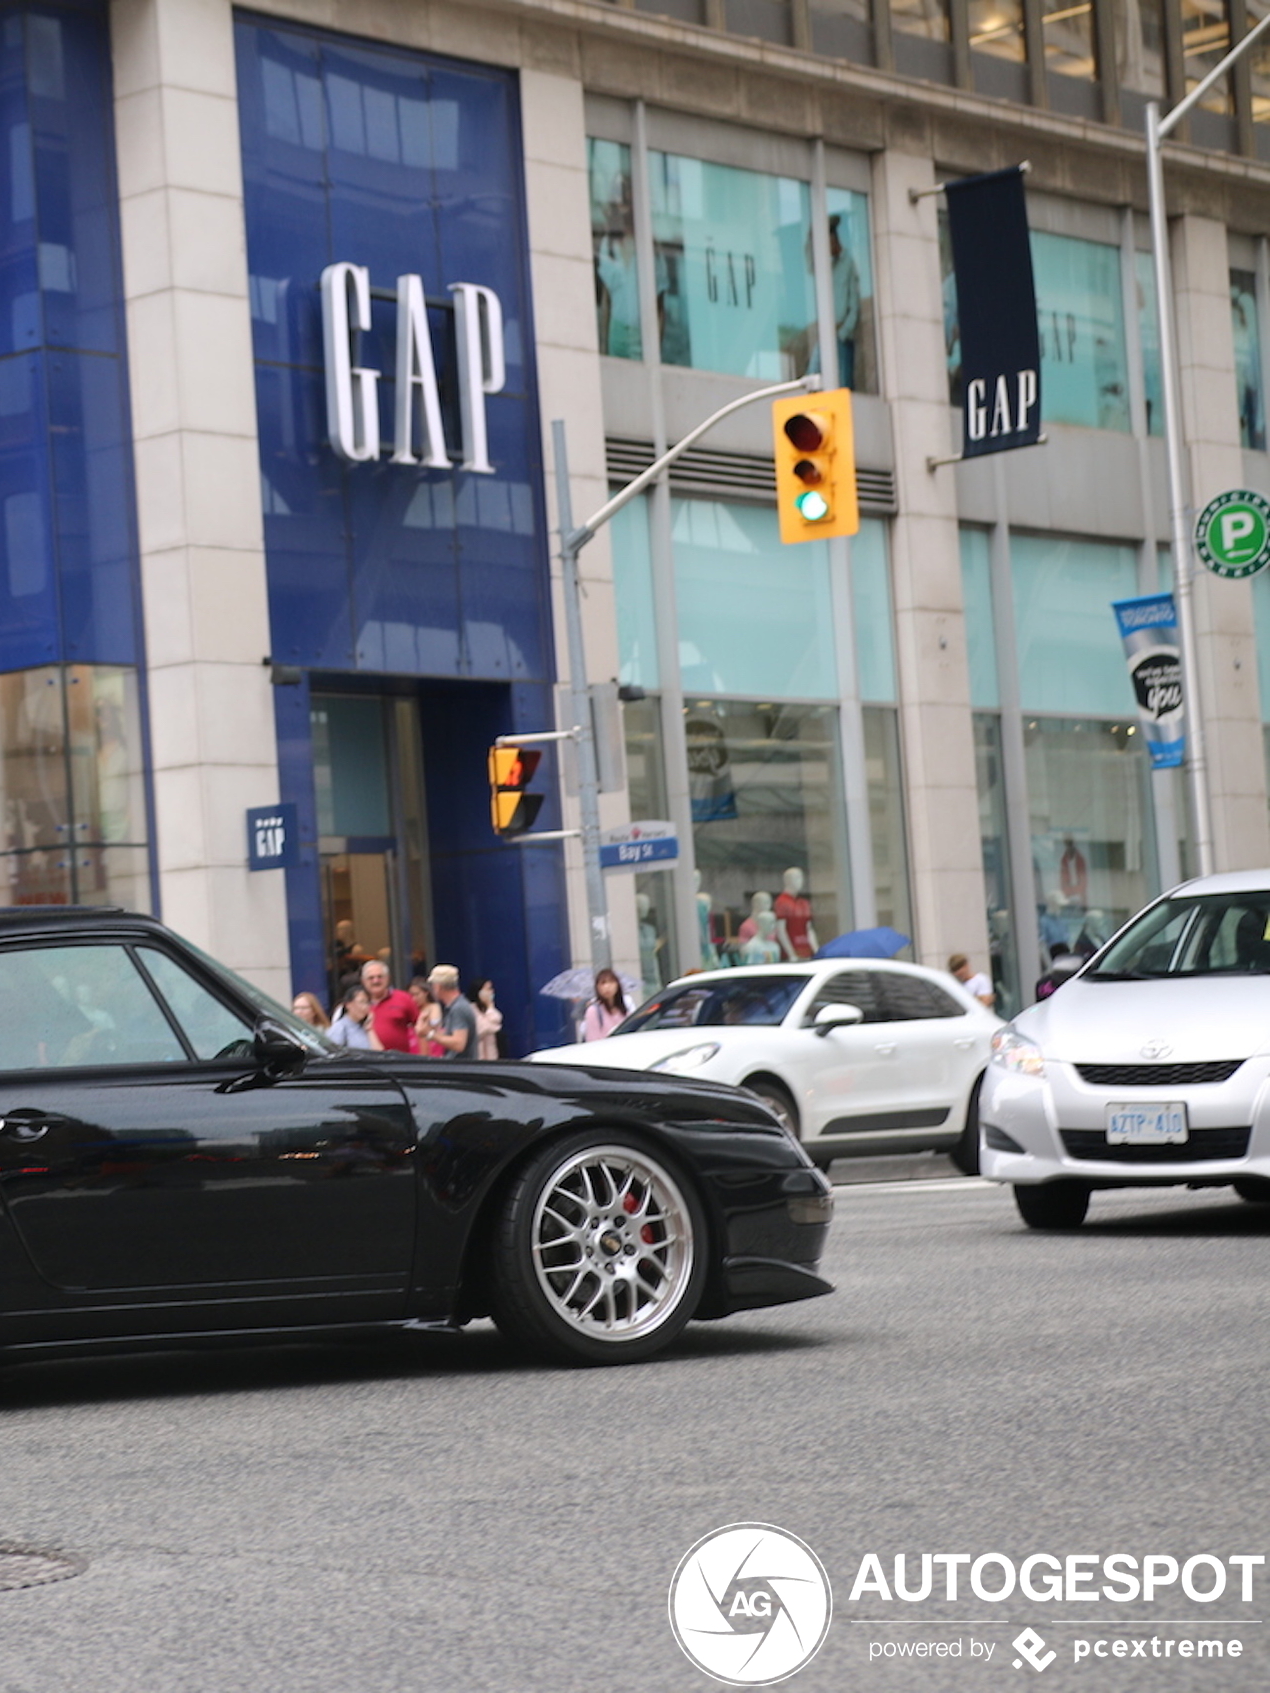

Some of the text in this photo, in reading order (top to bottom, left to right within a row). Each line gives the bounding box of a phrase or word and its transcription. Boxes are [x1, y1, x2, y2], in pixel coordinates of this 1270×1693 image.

[705, 248, 756, 310] GAP
[320, 261, 506, 475] GAP
[967, 369, 1037, 442] GAP
[1220, 511, 1255, 550] P
[1147, 685, 1183, 716] you
[256, 827, 285, 858] GAP
[619, 844, 641, 862] Bay
